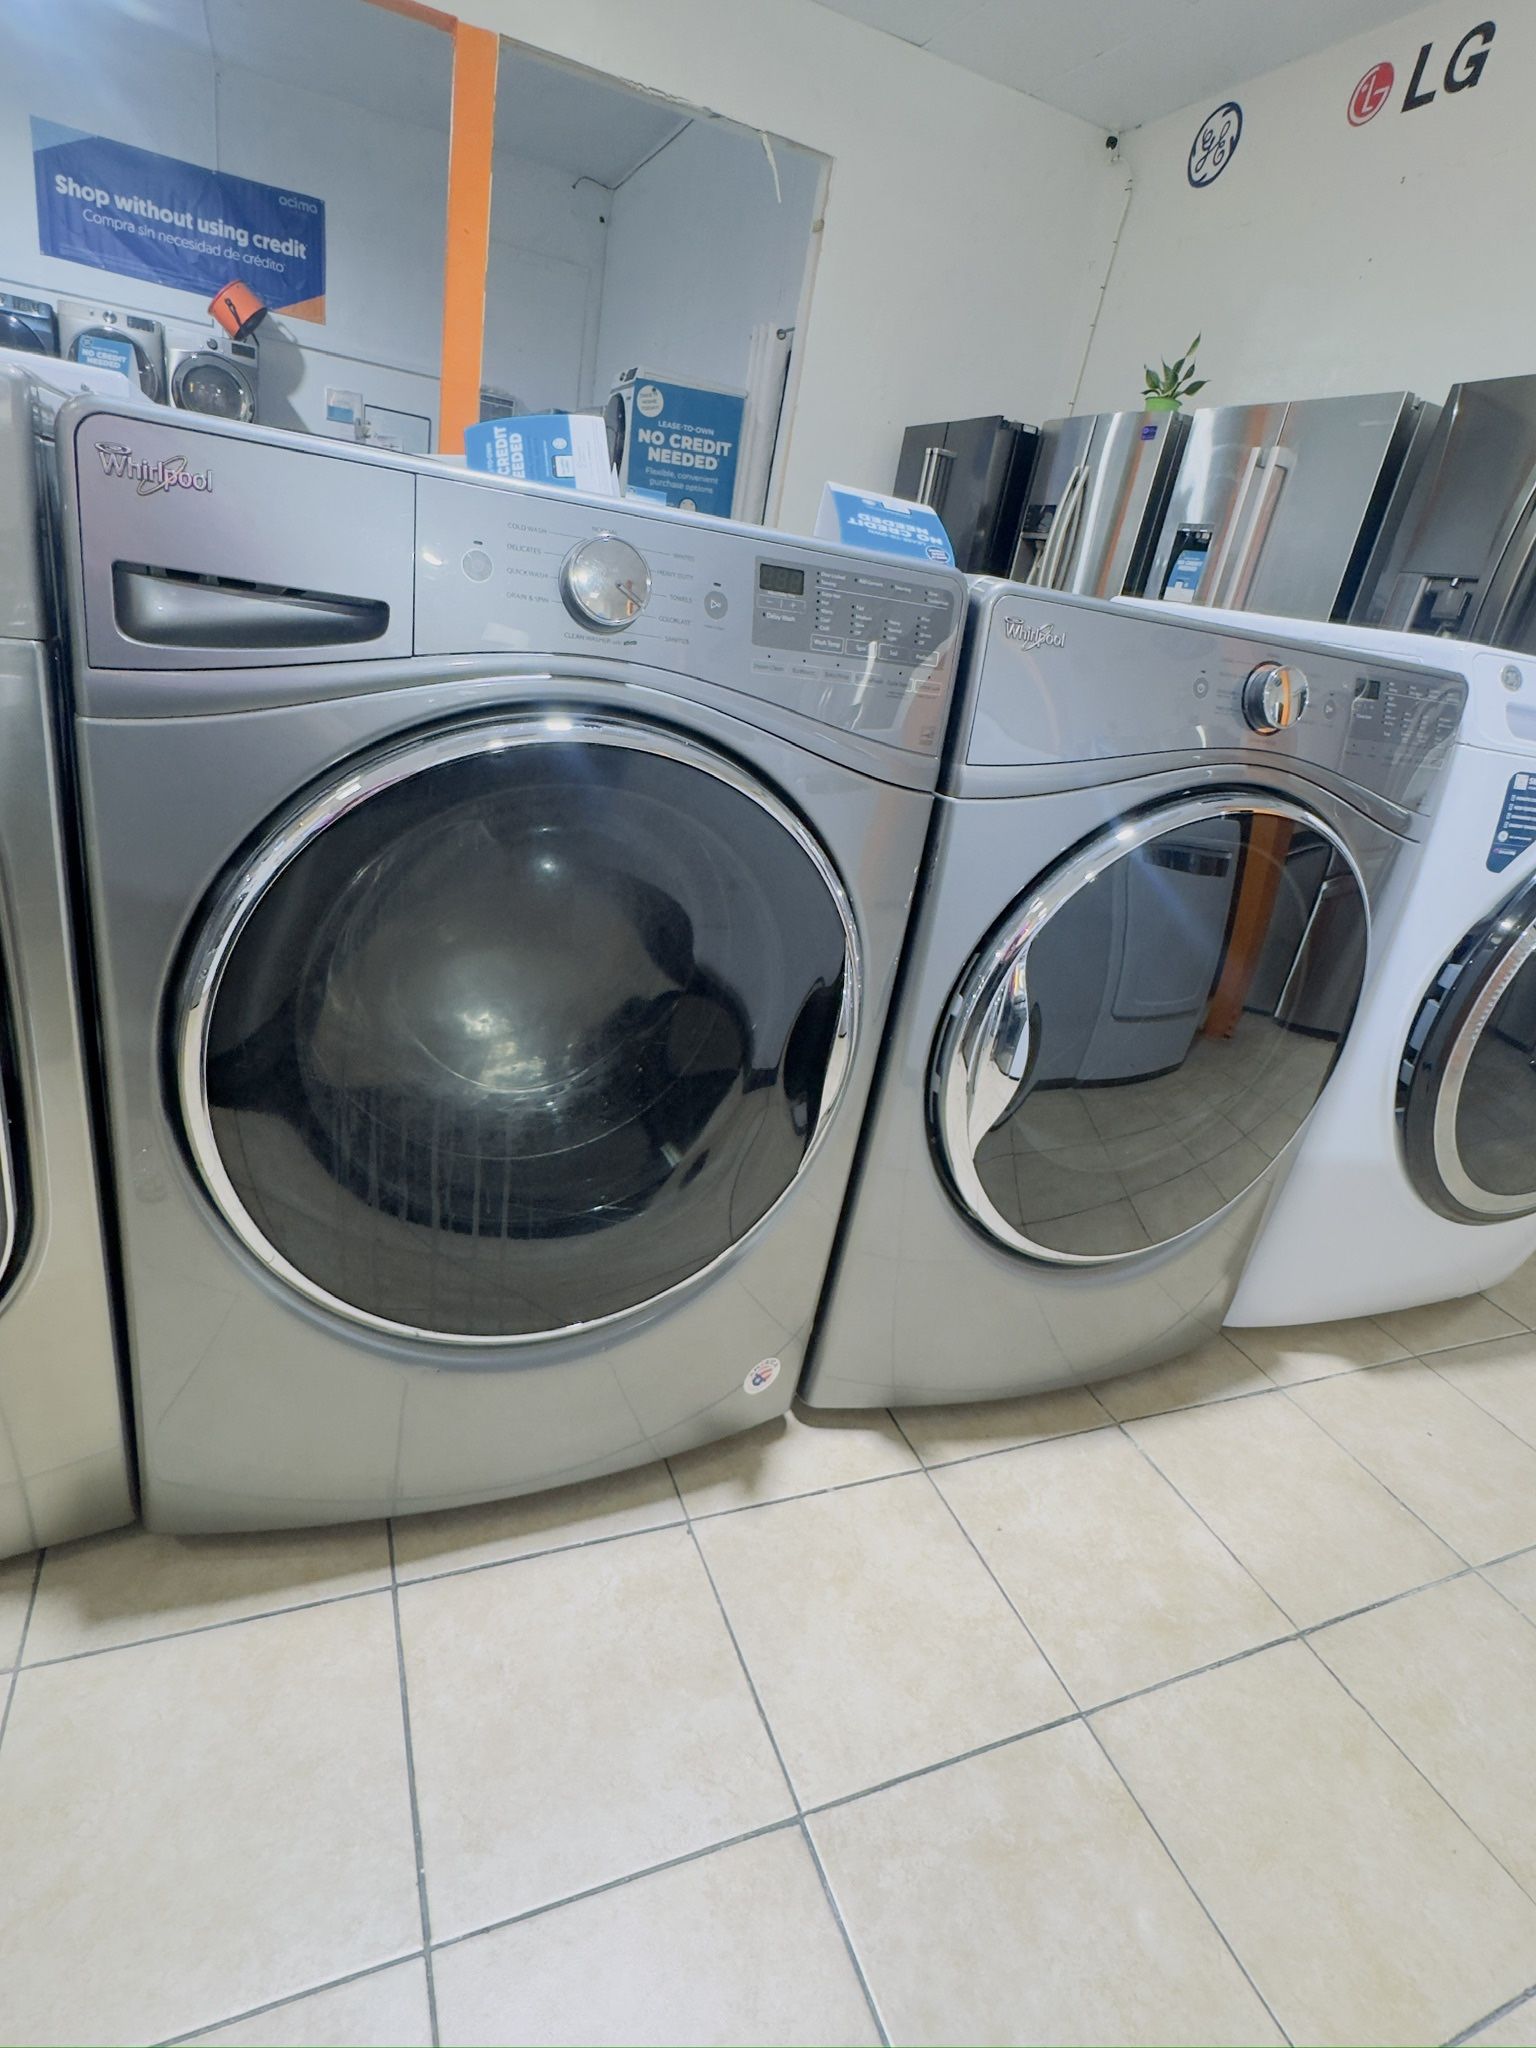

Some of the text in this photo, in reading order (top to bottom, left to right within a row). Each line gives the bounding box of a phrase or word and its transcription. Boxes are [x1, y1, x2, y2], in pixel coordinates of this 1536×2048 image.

[1401, 20, 1497, 113] LG
[55, 173, 307, 260] Shop without using credit
[278, 195, 318, 214] acima
[82, 208, 136, 232] Compra
[138, 224, 156, 240] sin
[158, 231, 221, 257] necesidad
[223, 246, 240, 261] de
[242, 253, 285, 273] crédito
[638, 428, 732, 457] NO CREDIT
[658, 420, 715, 436] LEASE-TO-OWN
[97, 443, 213, 494] Whirlpool
[493, 426, 510, 475] CREDIT
[509, 432, 526, 479] EEDED
[648, 446, 718, 470] NEEDED
[847, 516, 943, 546] NO CREDIT
[857, 512, 929, 536] NEEDED
[1004, 617, 1066, 653] Whirlpool
